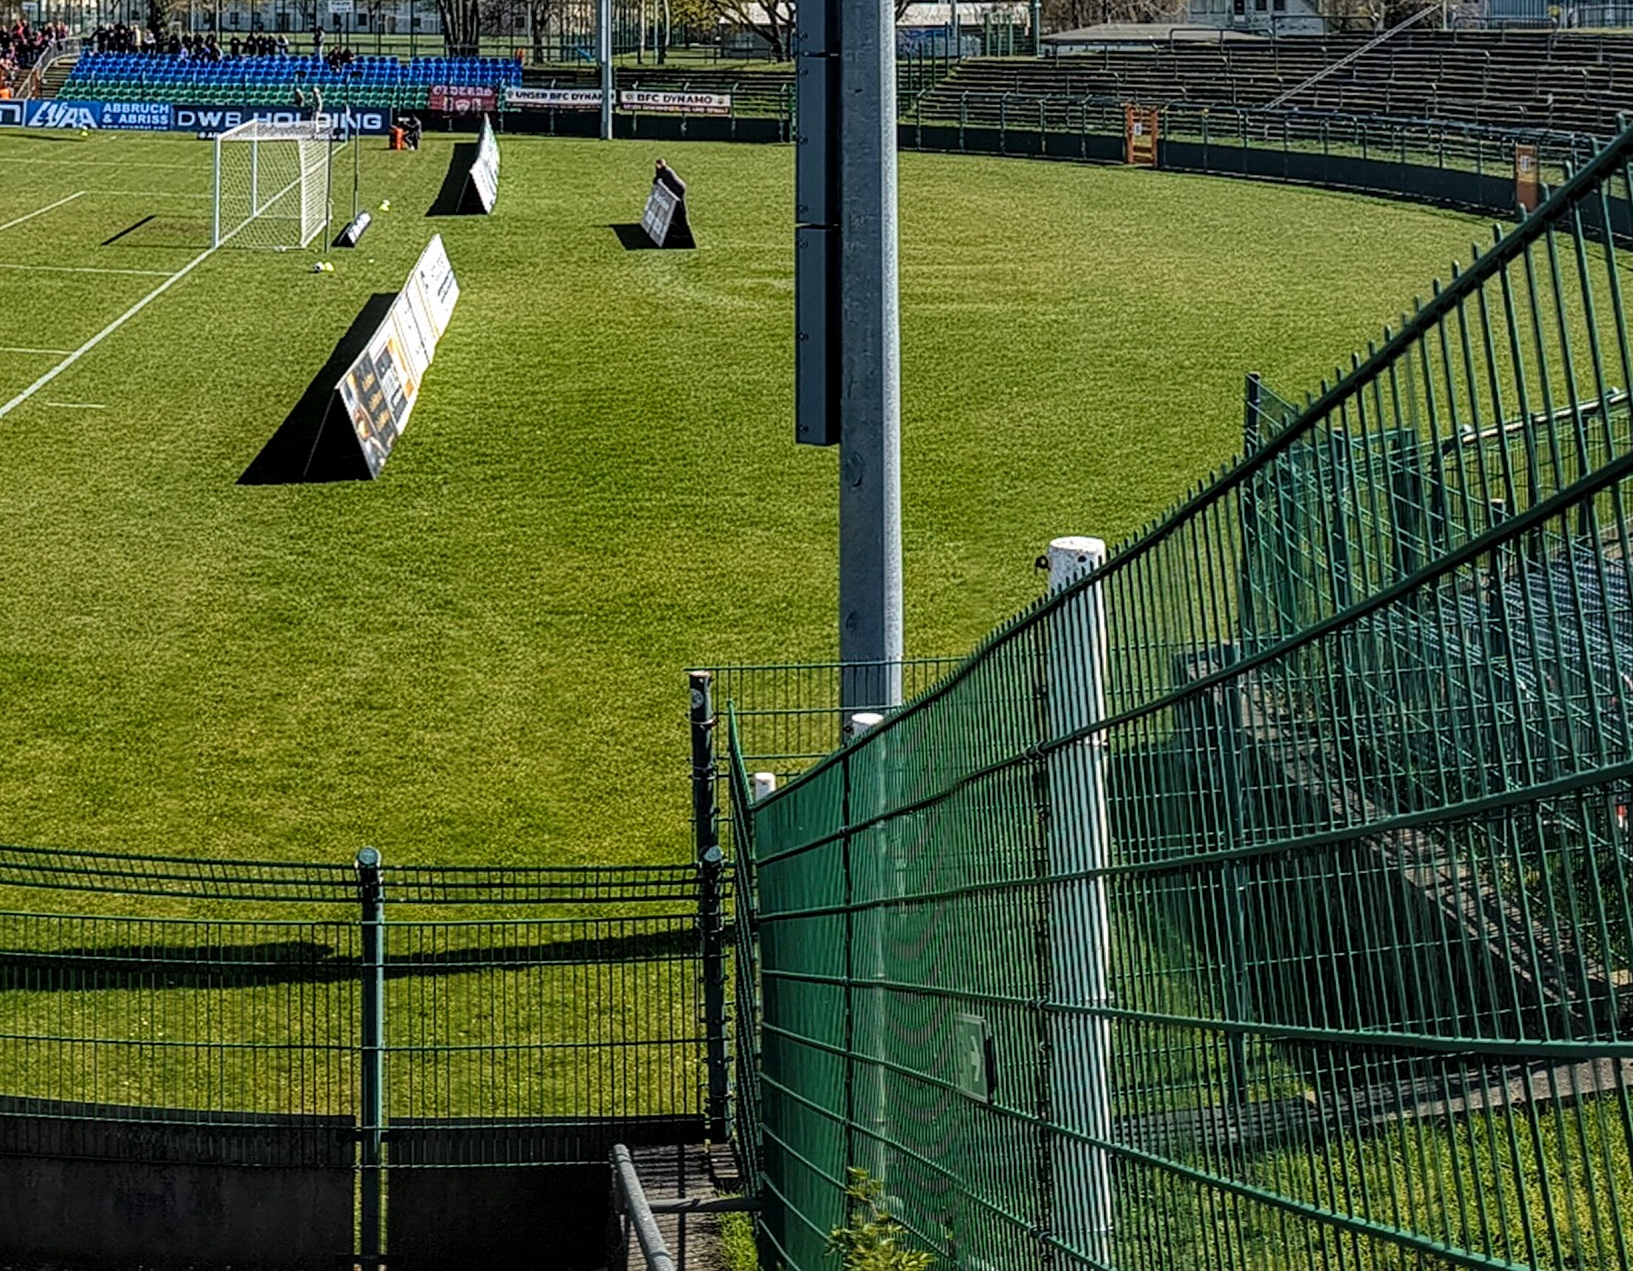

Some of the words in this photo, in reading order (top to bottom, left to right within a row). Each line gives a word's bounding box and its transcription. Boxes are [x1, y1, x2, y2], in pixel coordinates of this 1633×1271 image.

[637, 93, 660, 103] BFC
[663, 94, 713, 105] DYNAMO
[102, 102, 169, 114] ABBRUCH
[102, 114, 113, 123] &
[118, 114, 169, 125] ABRISS
[177, 109, 242, 128] DWB
